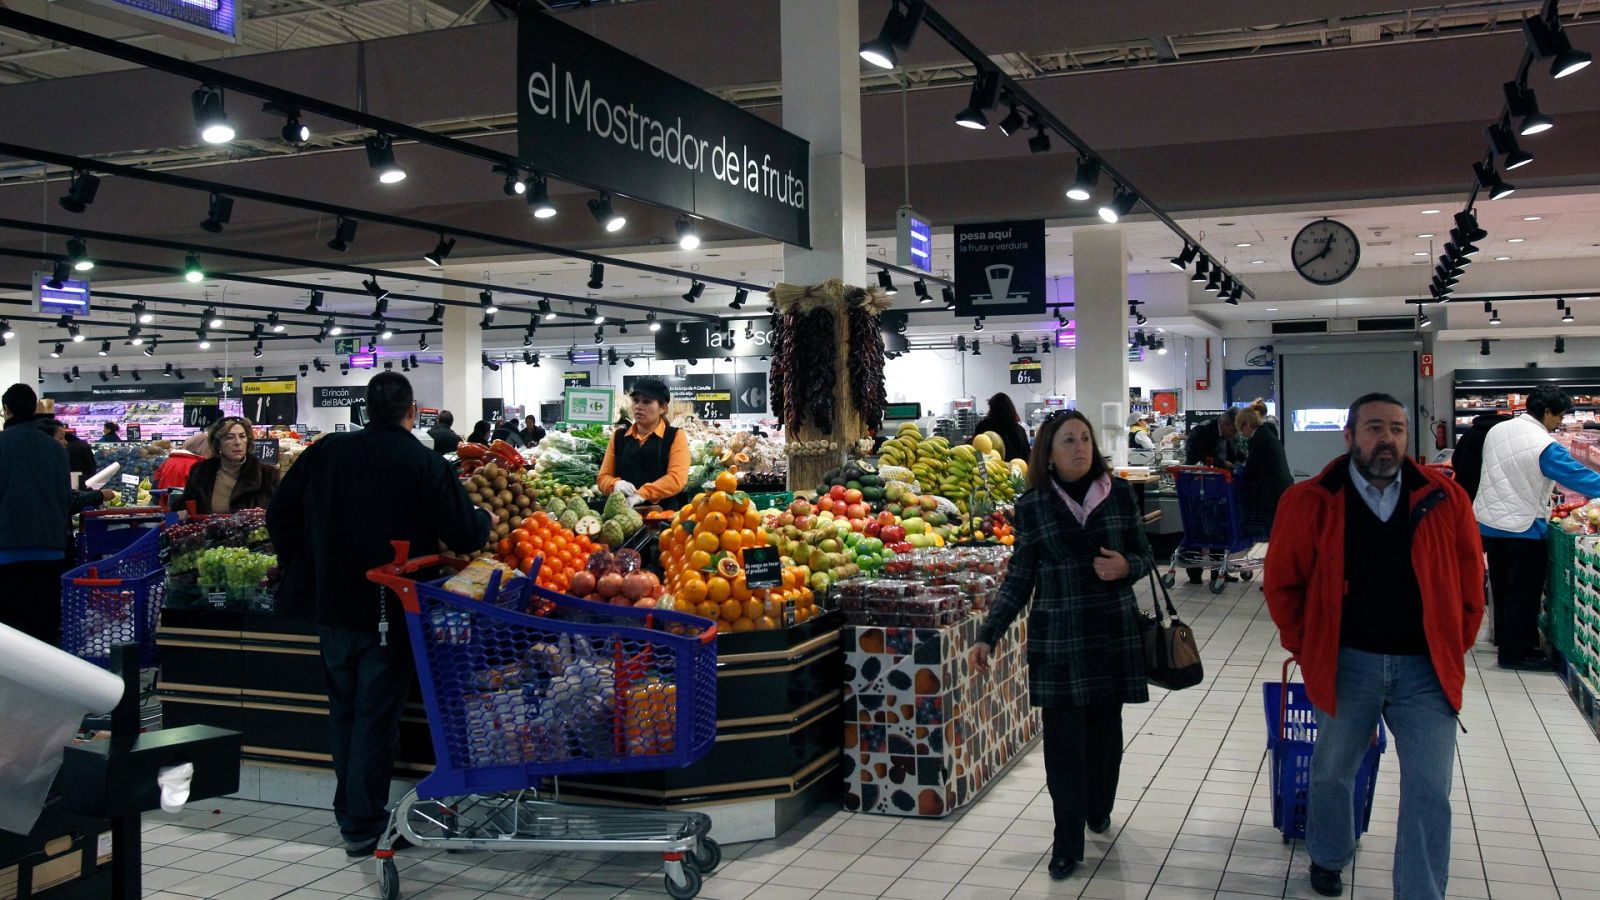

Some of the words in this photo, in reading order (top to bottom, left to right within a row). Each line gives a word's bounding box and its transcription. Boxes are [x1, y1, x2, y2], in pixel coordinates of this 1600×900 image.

[528, 62, 556, 119] el
[565, 71, 708, 174] Mostrador
[711, 135, 740, 186] de
[743, 144, 759, 193] la
[761, 153, 805, 209] fruta
[960, 231, 986, 242] pesa
[987, 227, 1013, 241] aquí
[960, 244, 967, 253] la
[968, 243, 989, 252] fruta
[989, 244, 996, 253] y
[996, 241, 1028, 251] verdura
[706, 328, 722, 347] la
[321, 389, 328, 397] El
[328, 388, 349, 397] rincón
[321, 398, 332, 406] del
